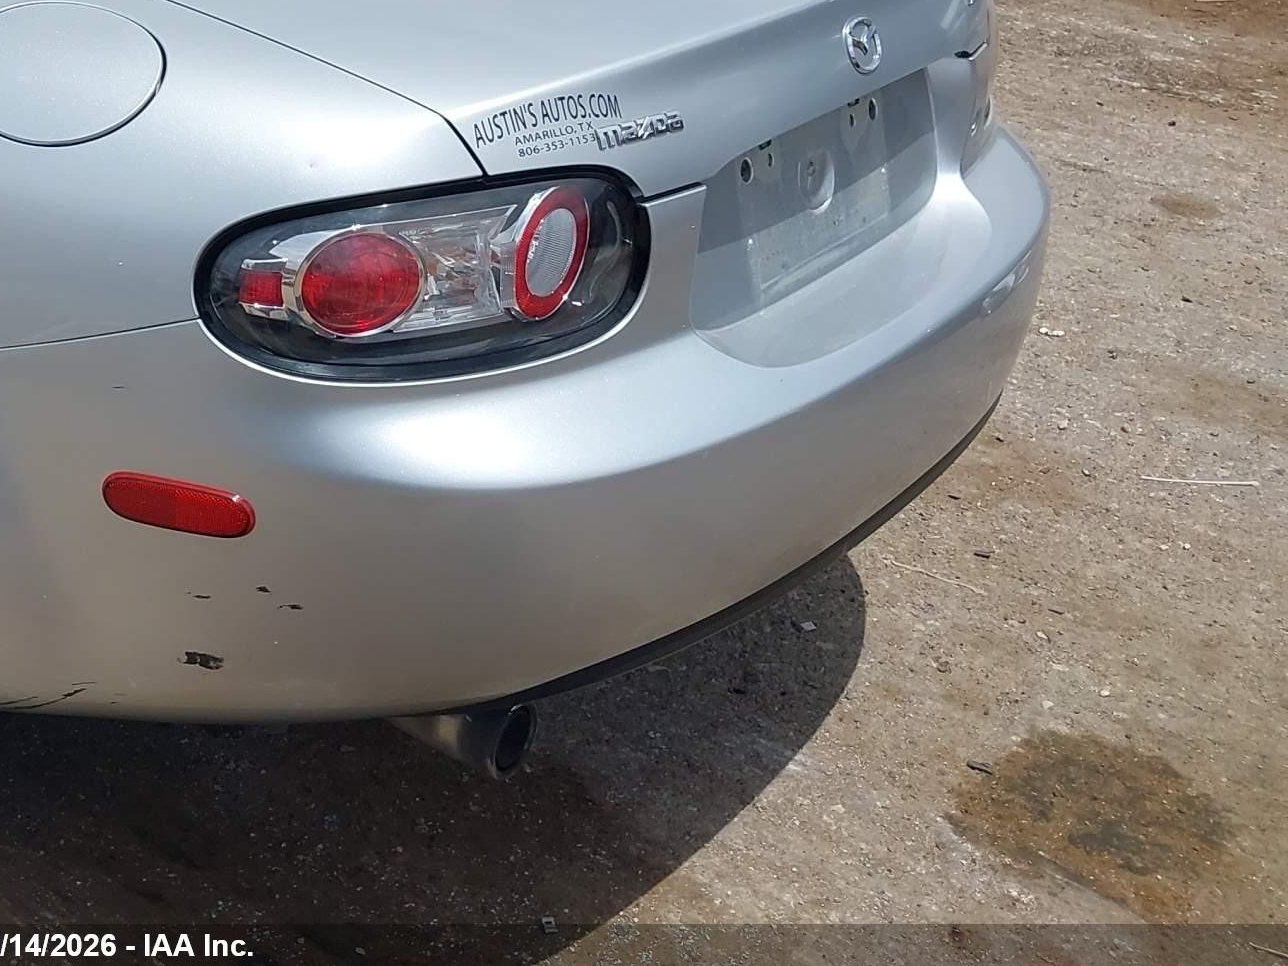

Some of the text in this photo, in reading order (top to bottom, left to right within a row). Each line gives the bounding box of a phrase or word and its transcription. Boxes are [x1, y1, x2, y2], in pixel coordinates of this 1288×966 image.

[473, 93, 623, 148] AUSTIN'S AUTOS.COM
[518, 133, 596, 157] 806-353-1153
